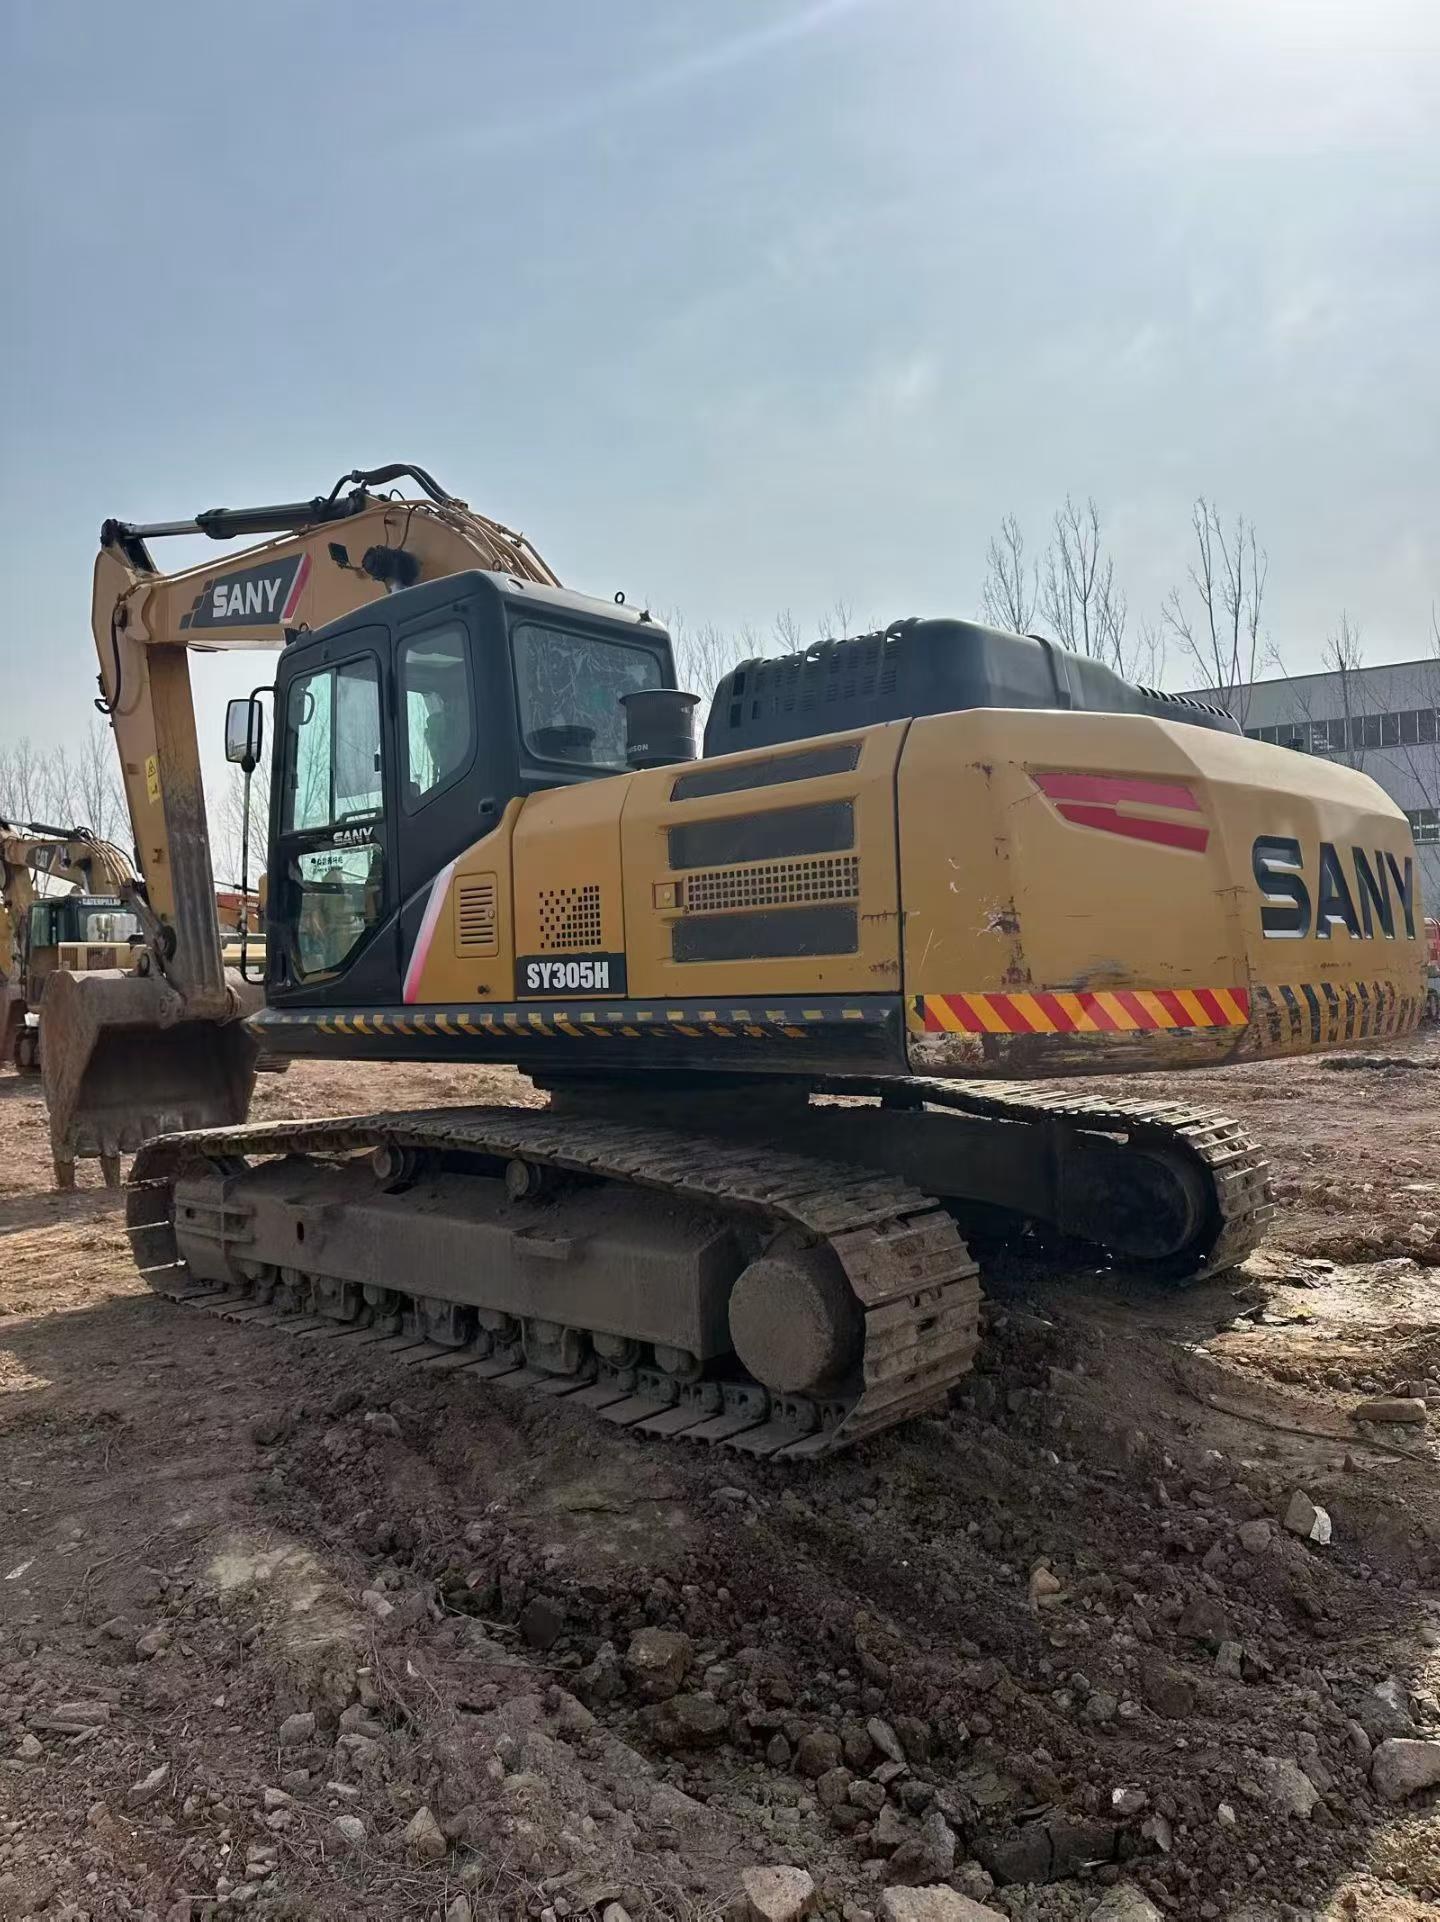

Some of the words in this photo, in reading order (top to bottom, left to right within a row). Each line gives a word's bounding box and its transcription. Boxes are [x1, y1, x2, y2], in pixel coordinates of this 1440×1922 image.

[212, 578, 282, 618] SANY
[333, 826, 374, 846] SANY
[1252, 835, 1416, 940] SANY
[527, 961, 609, 989] SY305H
